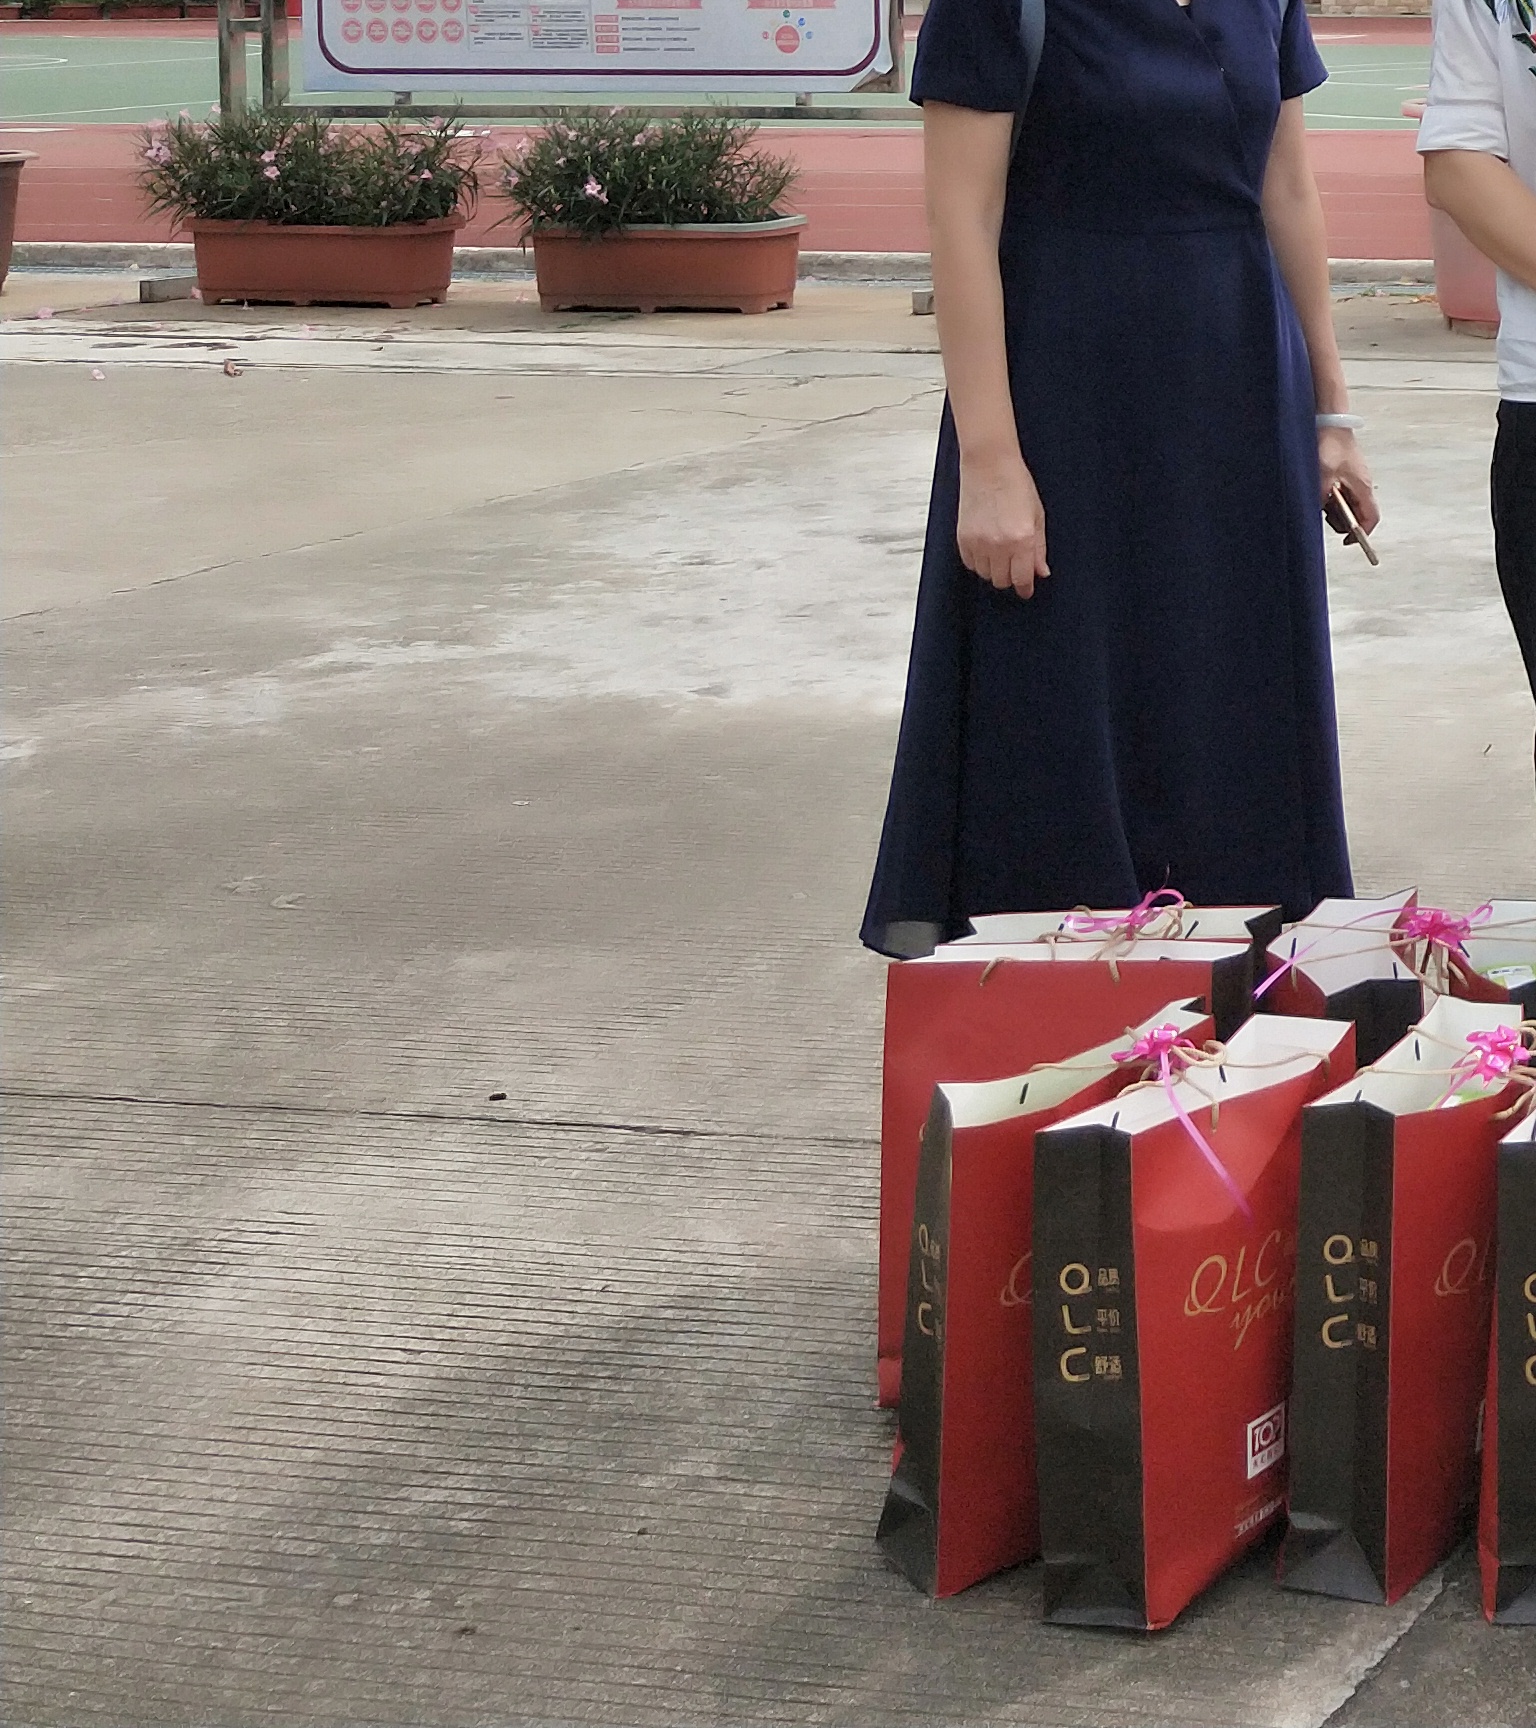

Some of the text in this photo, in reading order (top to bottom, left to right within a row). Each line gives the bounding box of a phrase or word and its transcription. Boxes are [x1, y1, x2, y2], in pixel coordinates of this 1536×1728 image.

[1323, 1234, 1355, 1265] Q
[1059, 1262, 1093, 1295] Q
[1184, 1229, 1281, 1317] QLC
[1325, 1273, 1354, 1304] L
[1061, 1304, 1092, 1335] L
[1322, 1313, 1353, 1349] C
[1059, 1346, 1091, 1383] C
